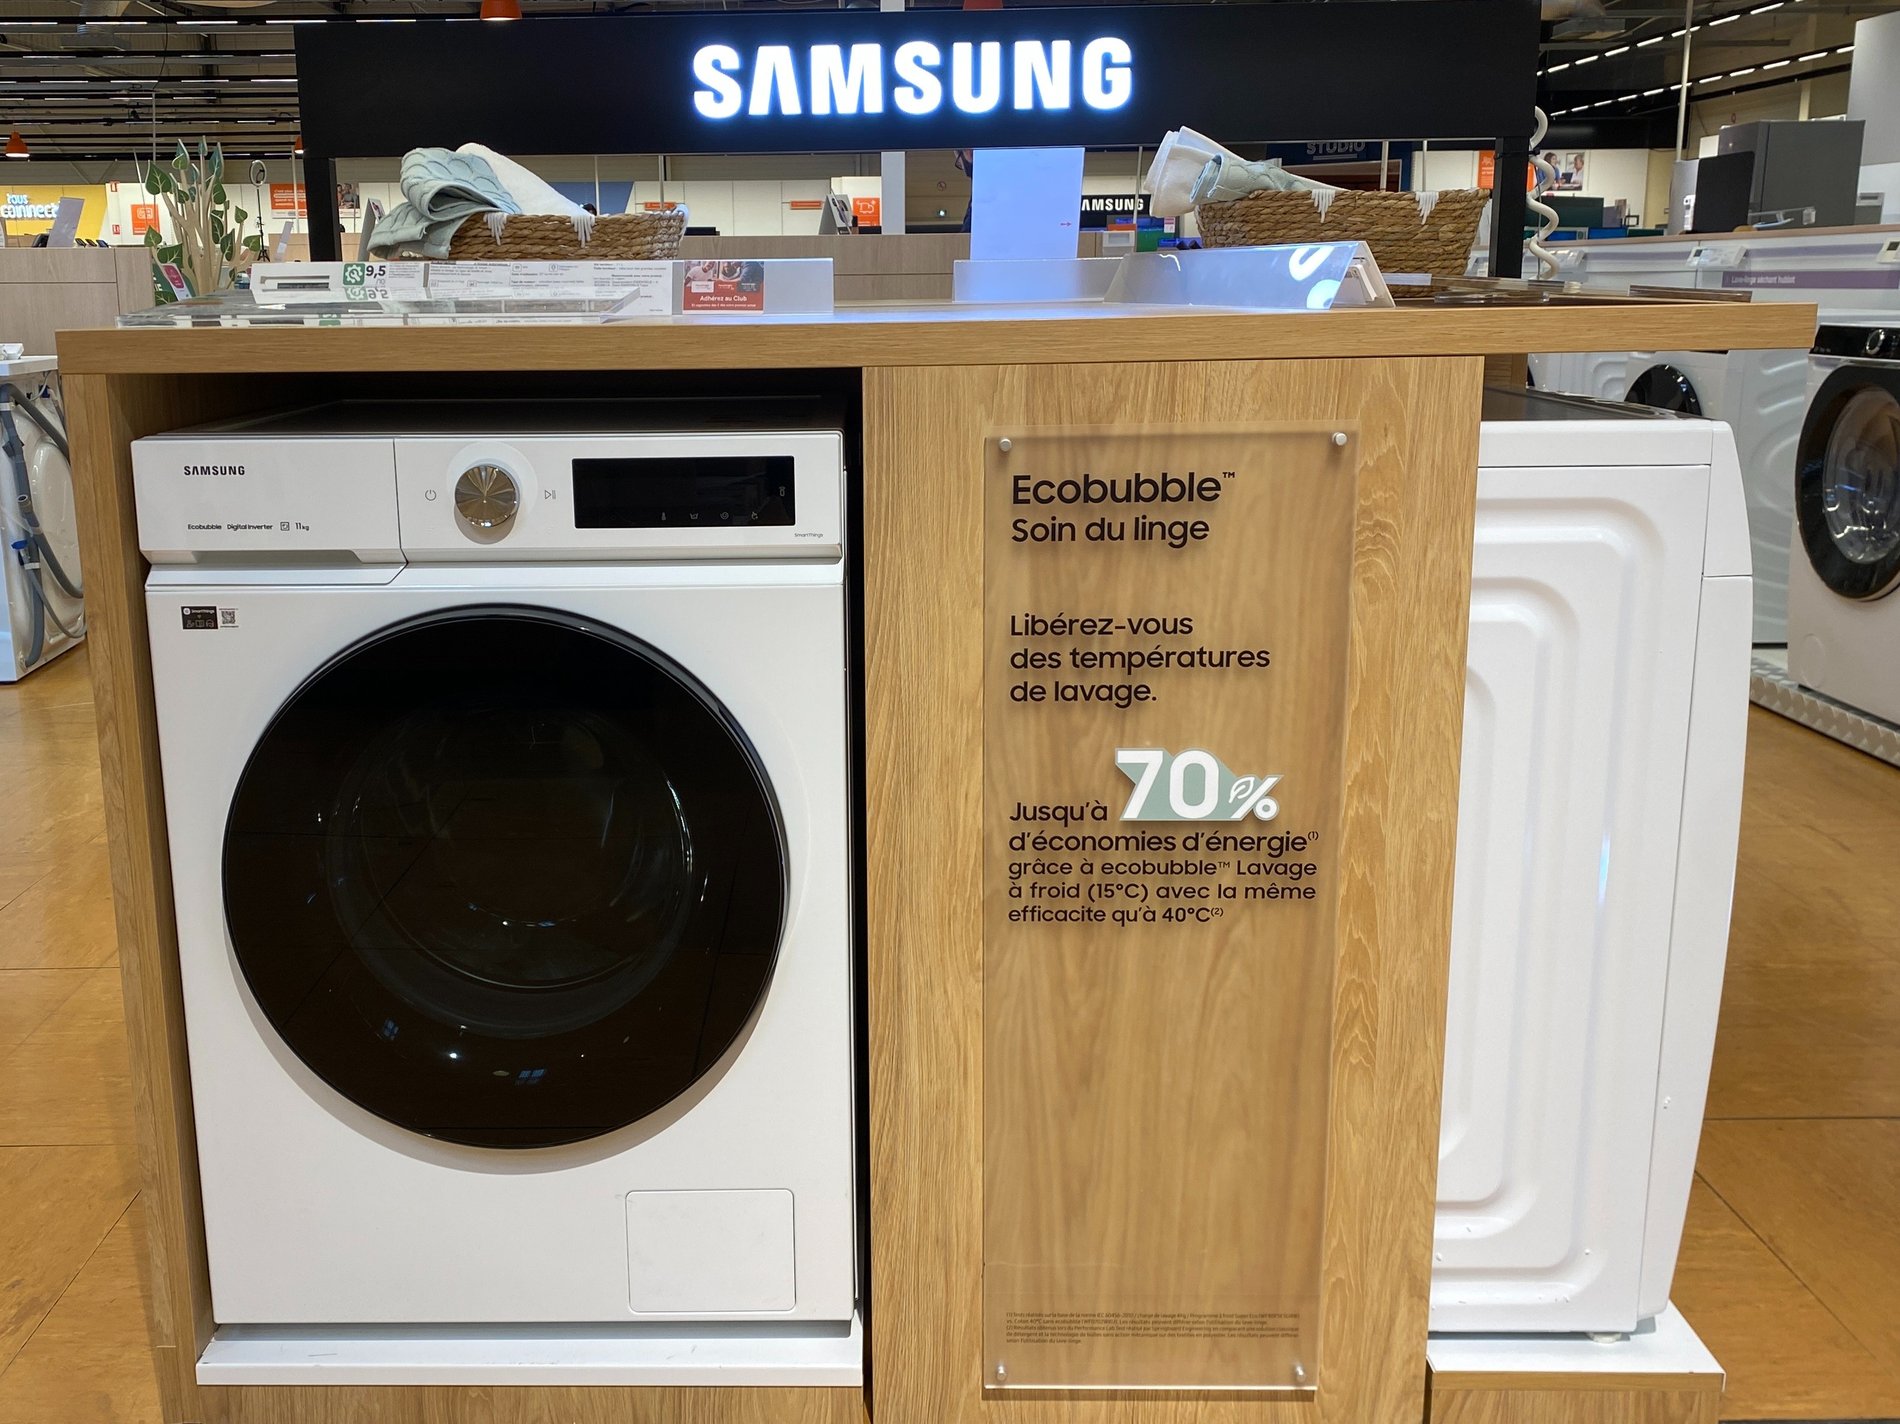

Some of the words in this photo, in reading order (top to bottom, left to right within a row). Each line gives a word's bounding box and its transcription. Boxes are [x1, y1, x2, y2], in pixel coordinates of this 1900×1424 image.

[693, 37, 1132, 119] SAMSUNG
[1082, 198, 1144, 211] AMSUNG
[366, 265, 386, 279] 9,5
[184, 465, 245, 476] SAMSUNG
[227, 523, 247, 531] Digital
[1011, 515, 1076, 543] Soin
[1085, 517, 1125, 541] du
[1134, 515, 1210, 549] linge
[1010, 612, 1194, 636] Libérez-vous
[1010, 648, 1062, 669] des
[1069, 645, 1271, 676] températures
[1010, 681, 1047, 702] de
[1054, 681, 1157, 709] lavage.
[1009, 800, 1108, 828] Jusqu'à
[1117, 750, 1279, 819] 70%
[1008, 831, 1176, 852] d'économies
[1008, 859, 1073, 880] grâce
[1080, 859, 1094, 876] à
[1237, 859, 1318, 881] Lavage
[1008, 883, 1022, 899] à
[1030, 882, 1080, 899] froid
[1087, 882, 1149, 903] (15°C)
[1155, 886, 1210, 900] avec
[1218, 883, 1238, 899] la
[1244, 883, 1316, 899] même
[1008, 905, 1106, 923] efficacite
[1111, 906, 1156, 927] qu'à
